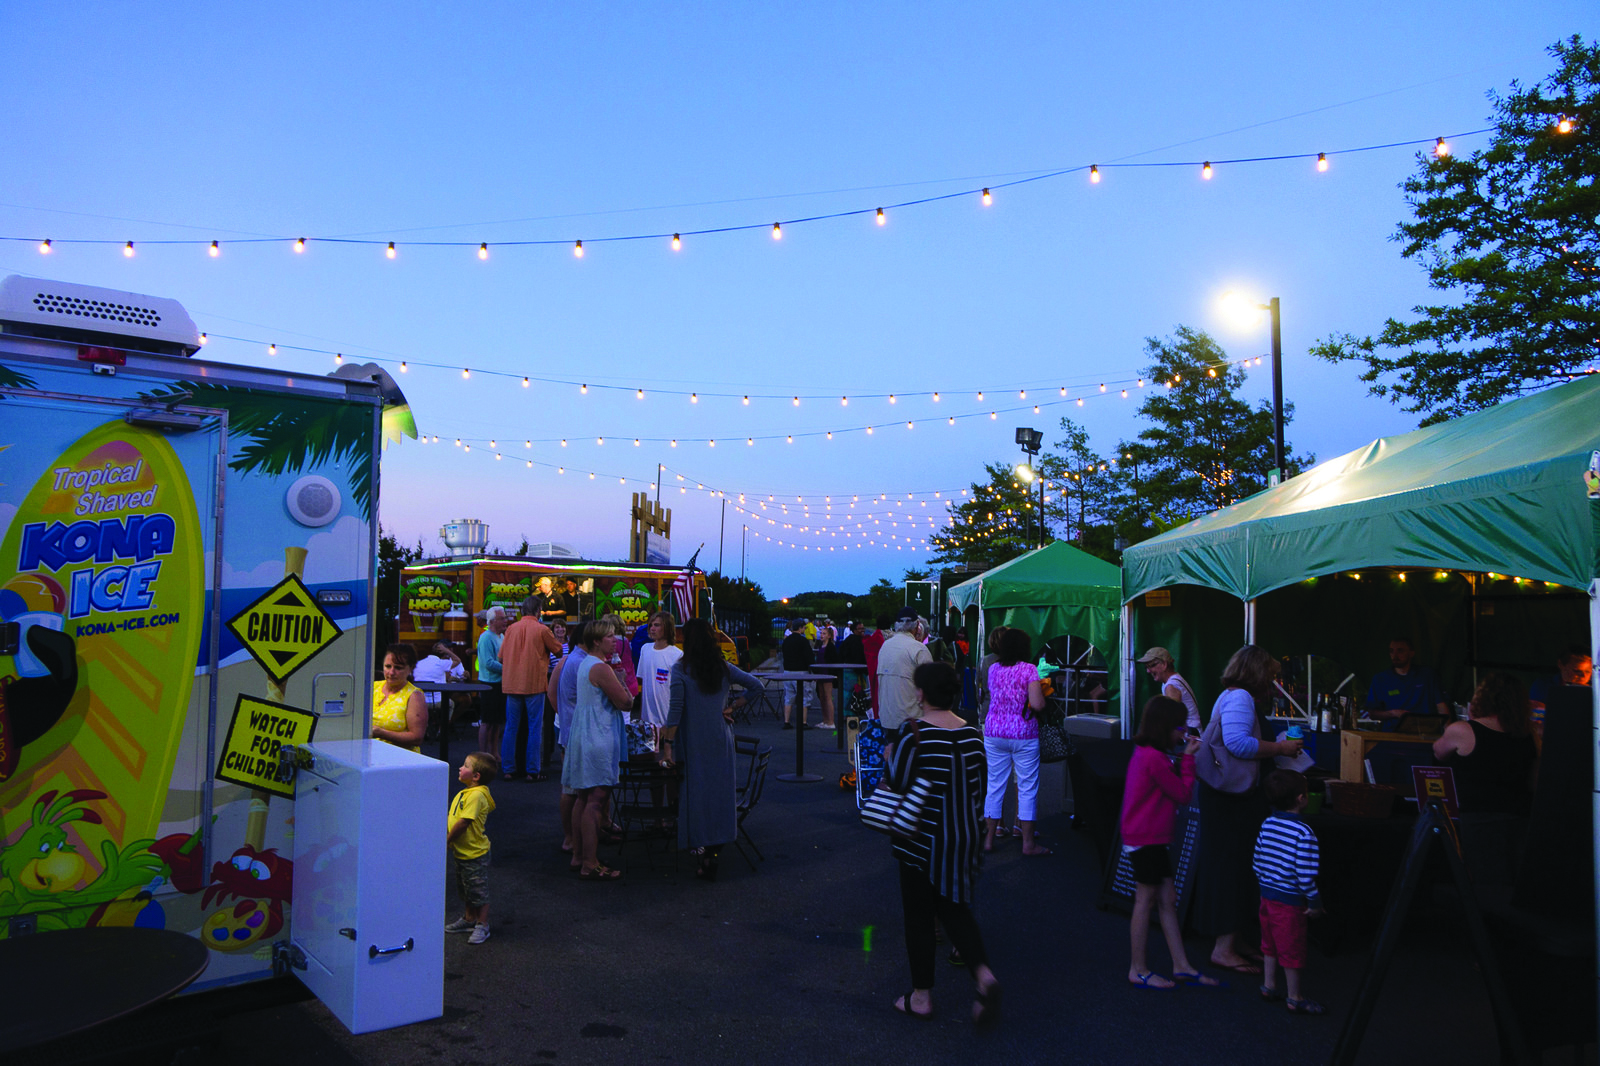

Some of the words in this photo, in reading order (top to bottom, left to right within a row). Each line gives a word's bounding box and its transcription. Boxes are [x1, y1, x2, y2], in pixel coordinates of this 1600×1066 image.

[53, 460, 143, 492] Tropical
[75, 484, 158, 516] Shaved
[17, 514, 175, 573] KONA
[69, 560, 162, 619] ICE
[408, 598, 451, 611] HOGG
[418, 585, 442, 598] SEA
[621, 596, 642, 609] SEA
[76, 612, 180, 637] KONA-ICE.COM
[247, 612, 323, 644] CAUTION
[250, 710, 297, 739] WATCH
[250, 735, 281, 758] FOR
[226, 751, 293, 786] CHILDRE
